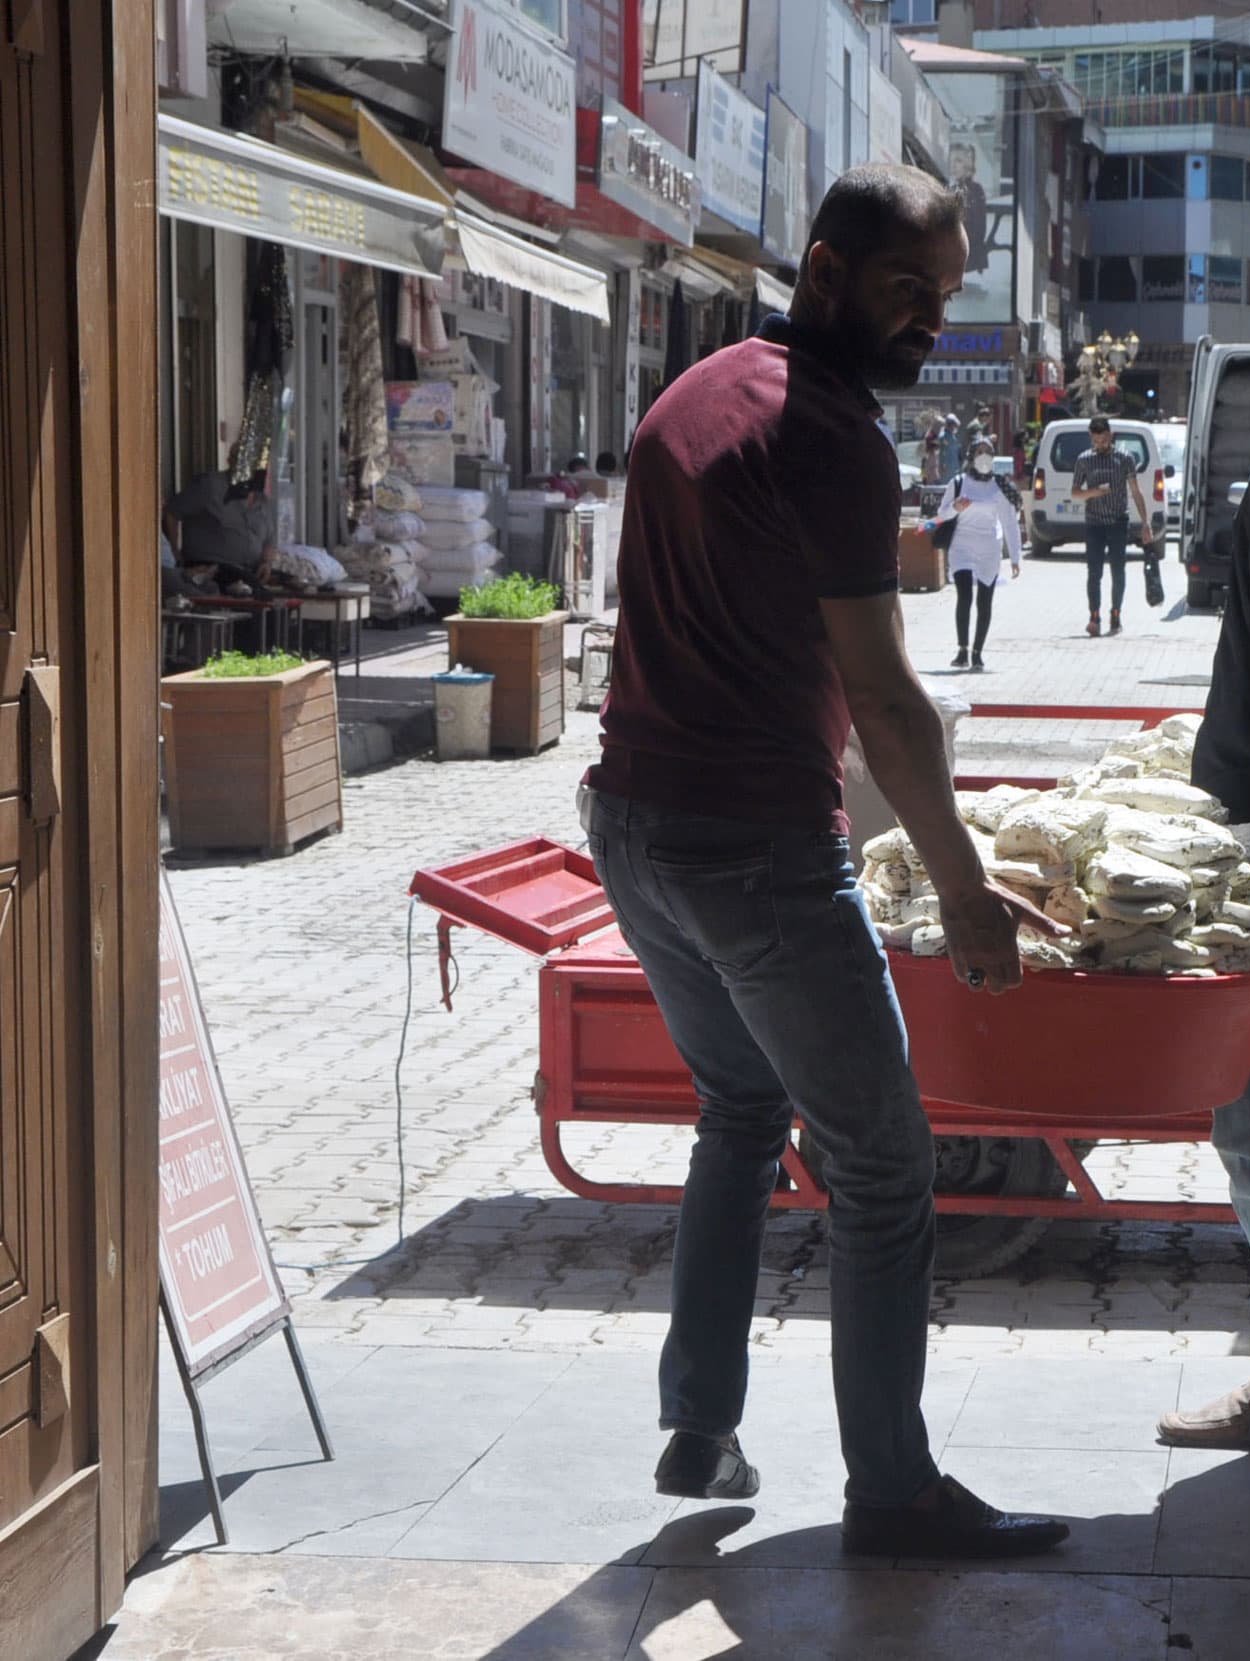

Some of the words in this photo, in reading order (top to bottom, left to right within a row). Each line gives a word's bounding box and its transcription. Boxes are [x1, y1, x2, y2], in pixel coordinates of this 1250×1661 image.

[484, 28, 571, 119] MODASAMODA
[934, 326, 1003, 353] mavi
[160, 1068, 204, 1120] KLİYAT
[183, 1223, 234, 1283] TOHUM
